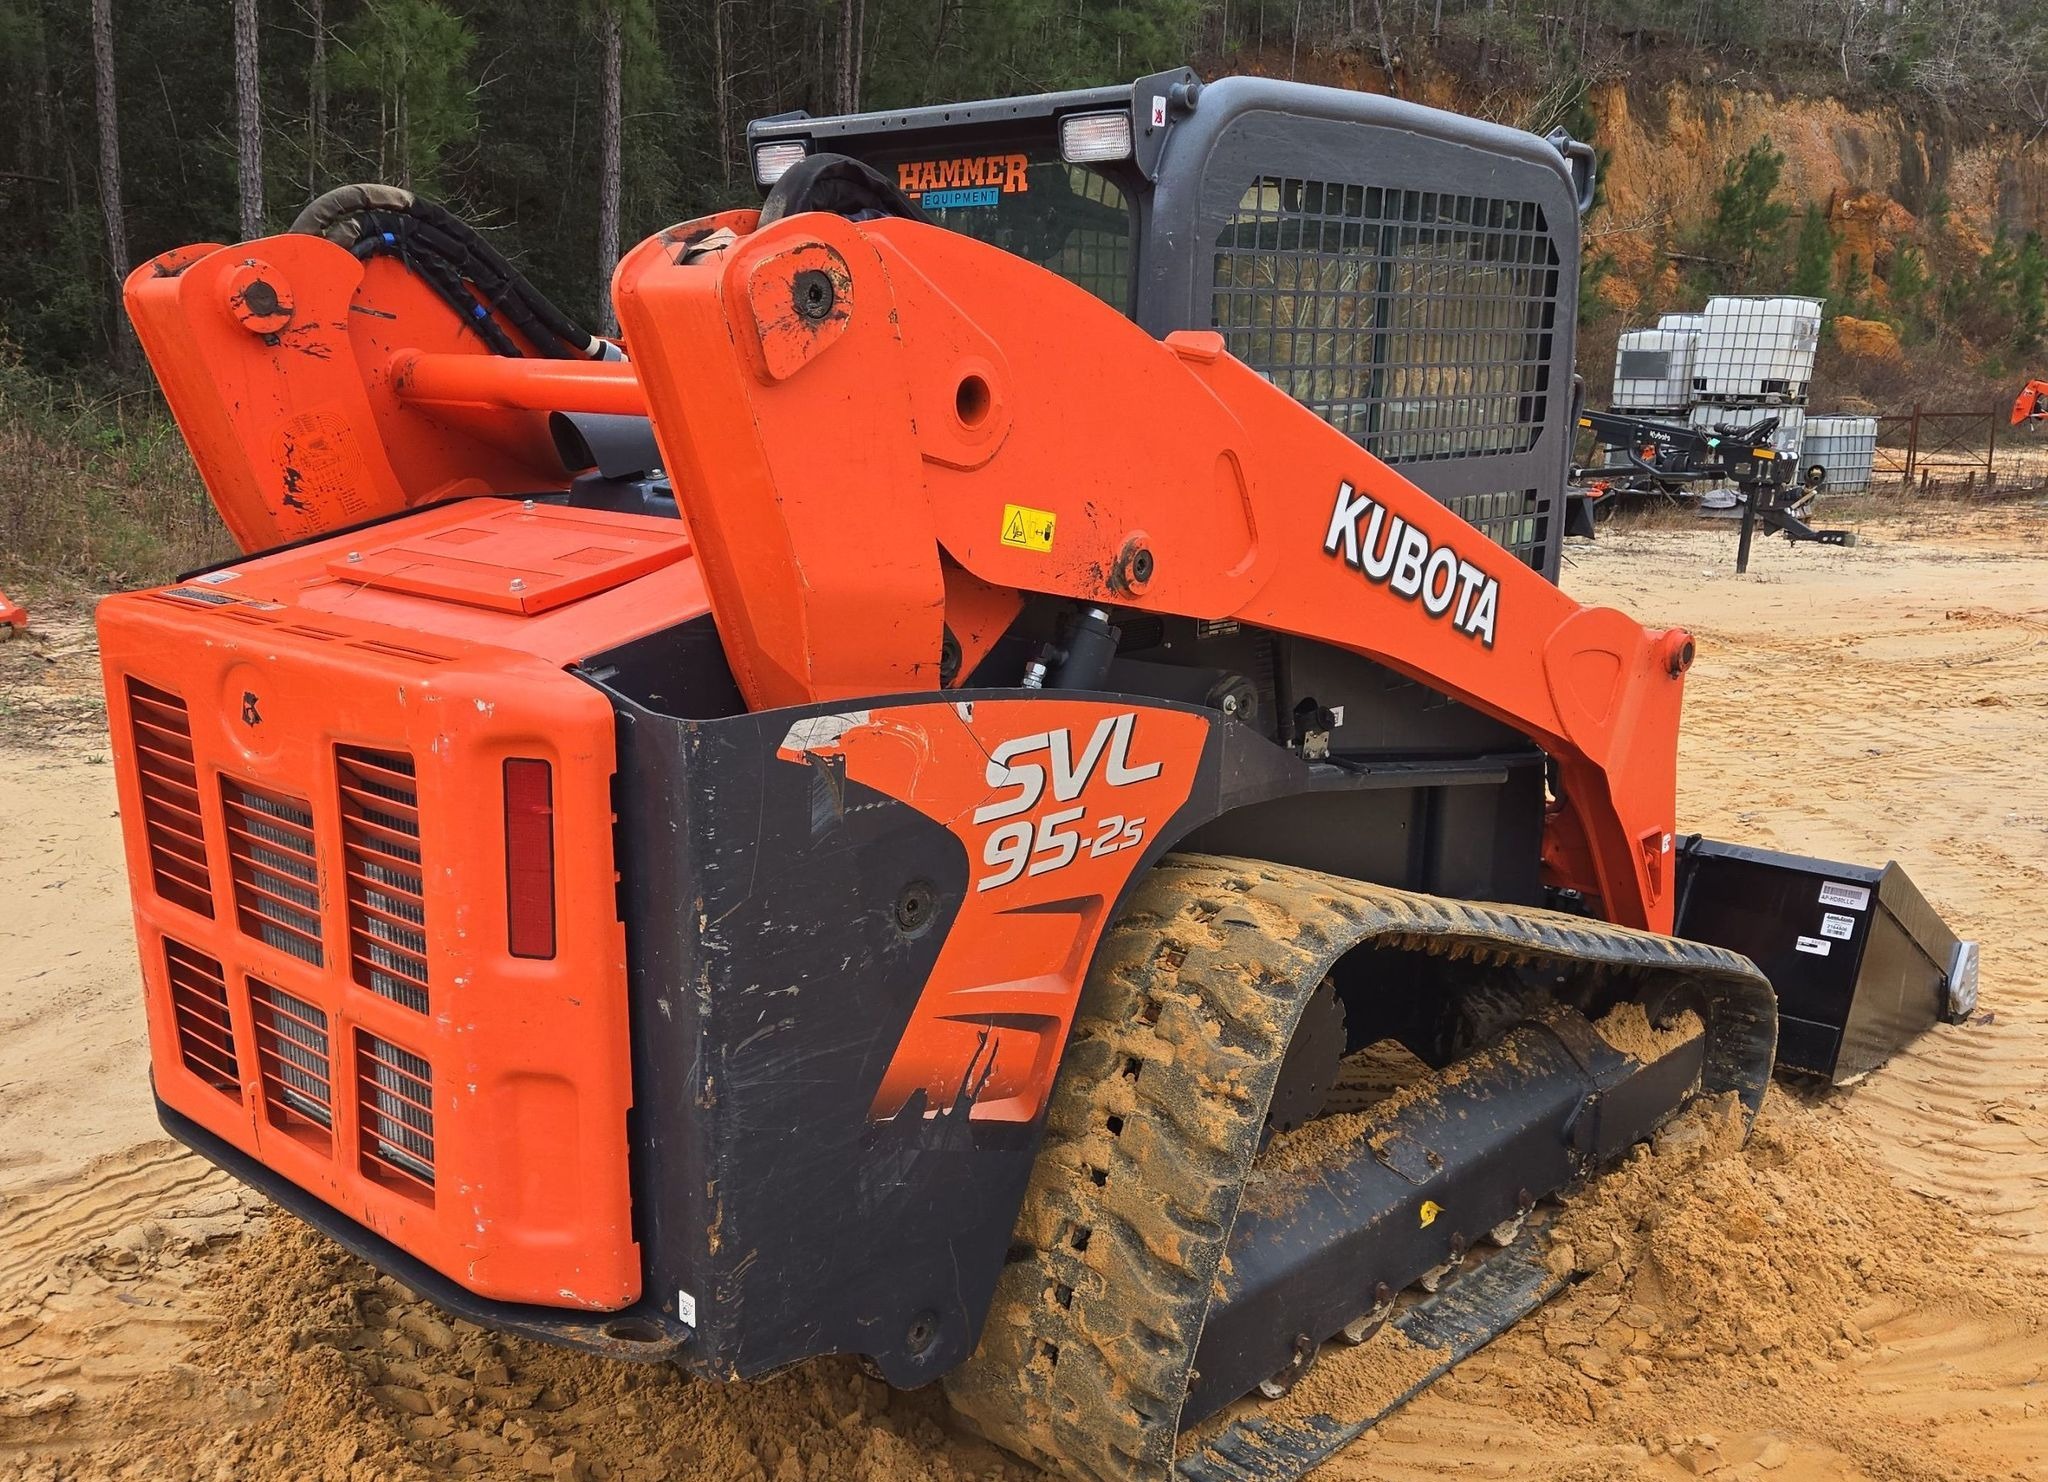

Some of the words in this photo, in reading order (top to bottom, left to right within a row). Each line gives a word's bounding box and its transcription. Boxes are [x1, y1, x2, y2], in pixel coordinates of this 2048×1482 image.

[898, 154, 1028, 193] HAMMER
[924, 190, 997, 206] EQUIPMENT
[1323, 480, 1499, 646] KUBOTA
[972, 712, 1164, 825] SVL
